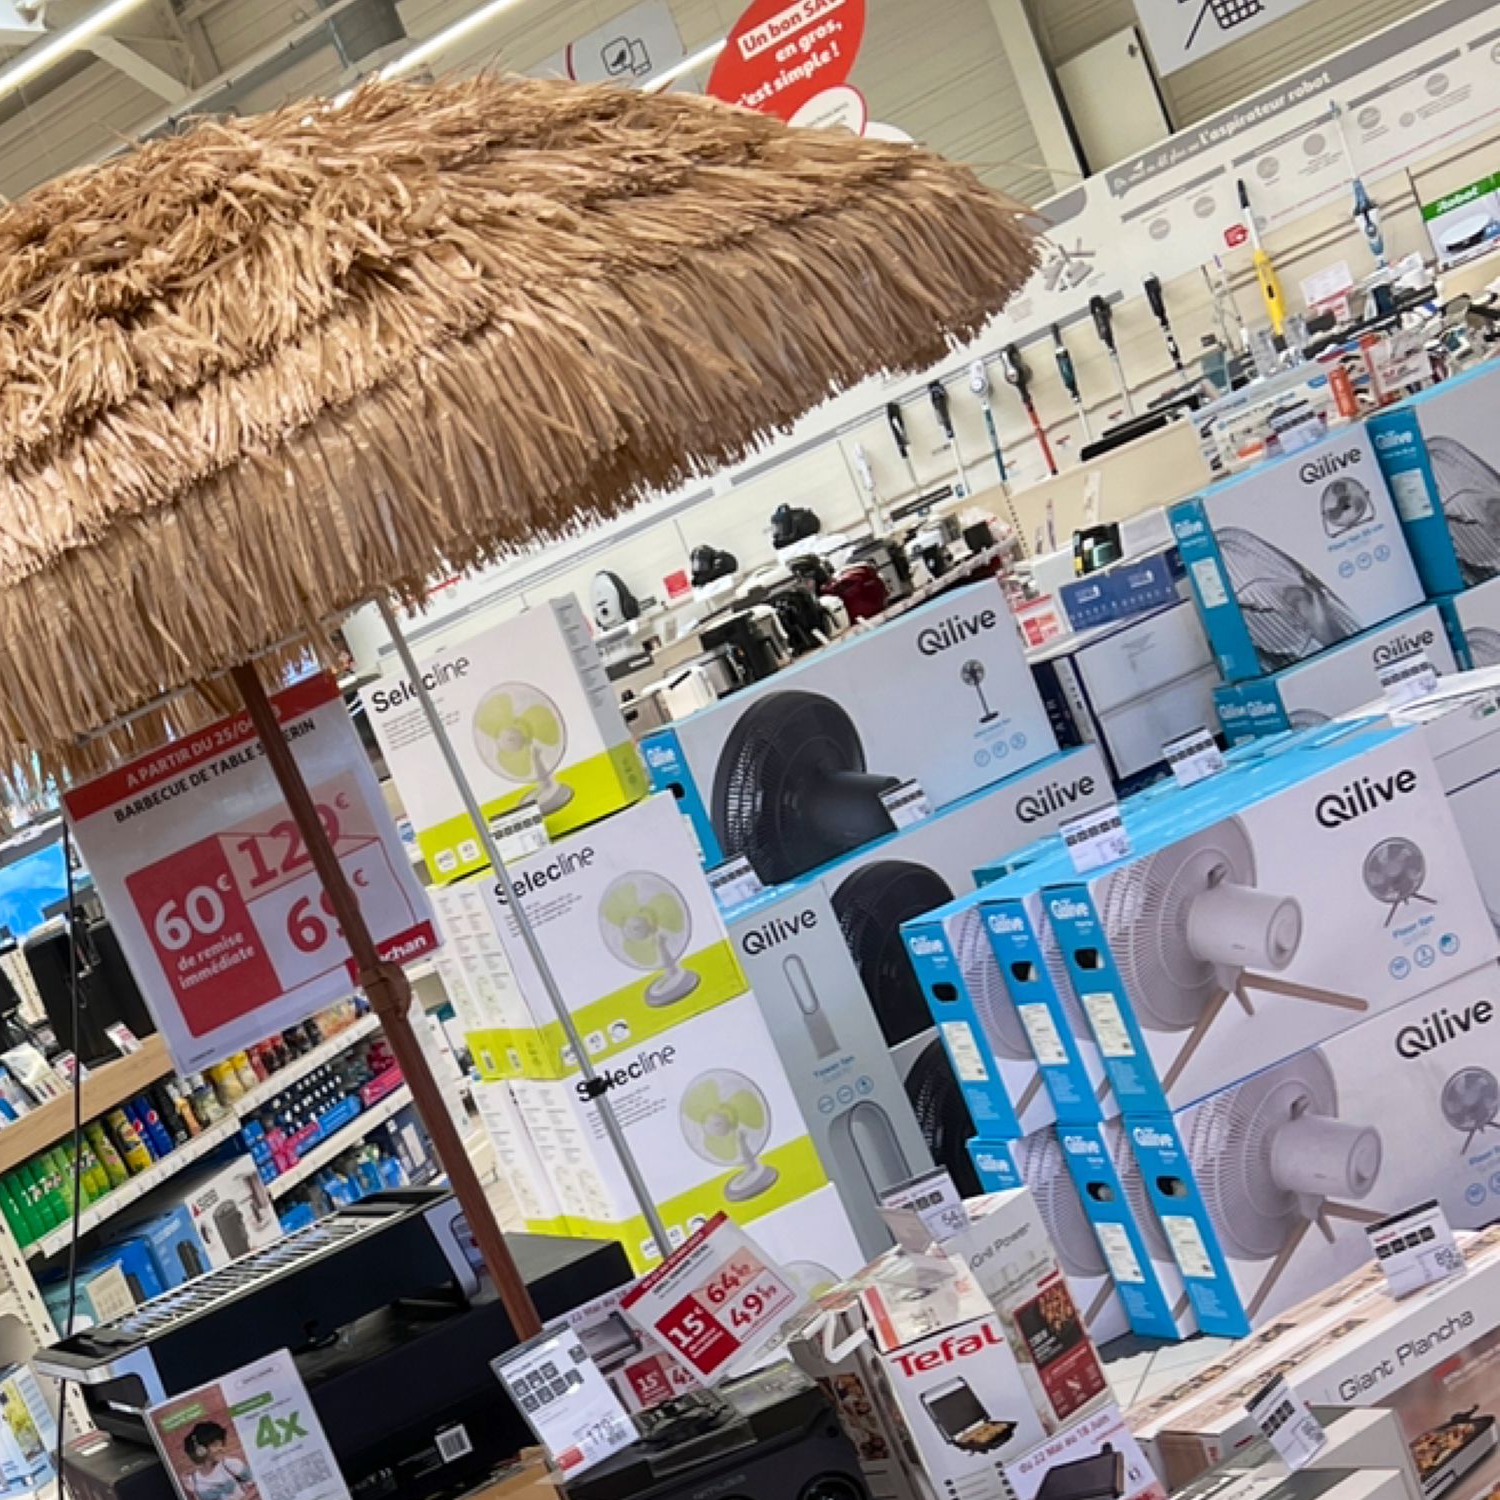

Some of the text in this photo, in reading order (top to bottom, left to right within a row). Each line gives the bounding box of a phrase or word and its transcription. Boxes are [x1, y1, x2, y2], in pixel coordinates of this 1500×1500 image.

[743, 32, 768, 51] Un
[768, 14, 802, 37] bon
[775, 19, 842, 62] en gros,
[773, 50, 830, 91] simple
[1285, 72, 1332, 102] robot
[1299, 449, 1362, 485] Qilive
[917, 609, 996, 655] Qilive
[1373, 629, 1434, 664] Qilive
[126, 735, 213, 788] A PARTIR DU
[114, 779, 188, 824] BARBECUE
[189, 770, 211, 789] DE
[211, 747, 256, 778] TABLE
[1016, 775, 1095, 823] Qilive
[1315, 770, 1417, 828] Qilive
[177, 931, 244, 972] de remise
[742, 908, 818, 954] Qilive
[178, 946, 256, 990] immédiate
[1396, 1000, 1494, 1059] Qilive
[576, 1045, 675, 1102] Slecline
[890, 1323, 1004, 1379] Tefal
[1338, 1310, 1475, 1403] Giant Plancha
[255, 1410, 309, 1449] 4x
